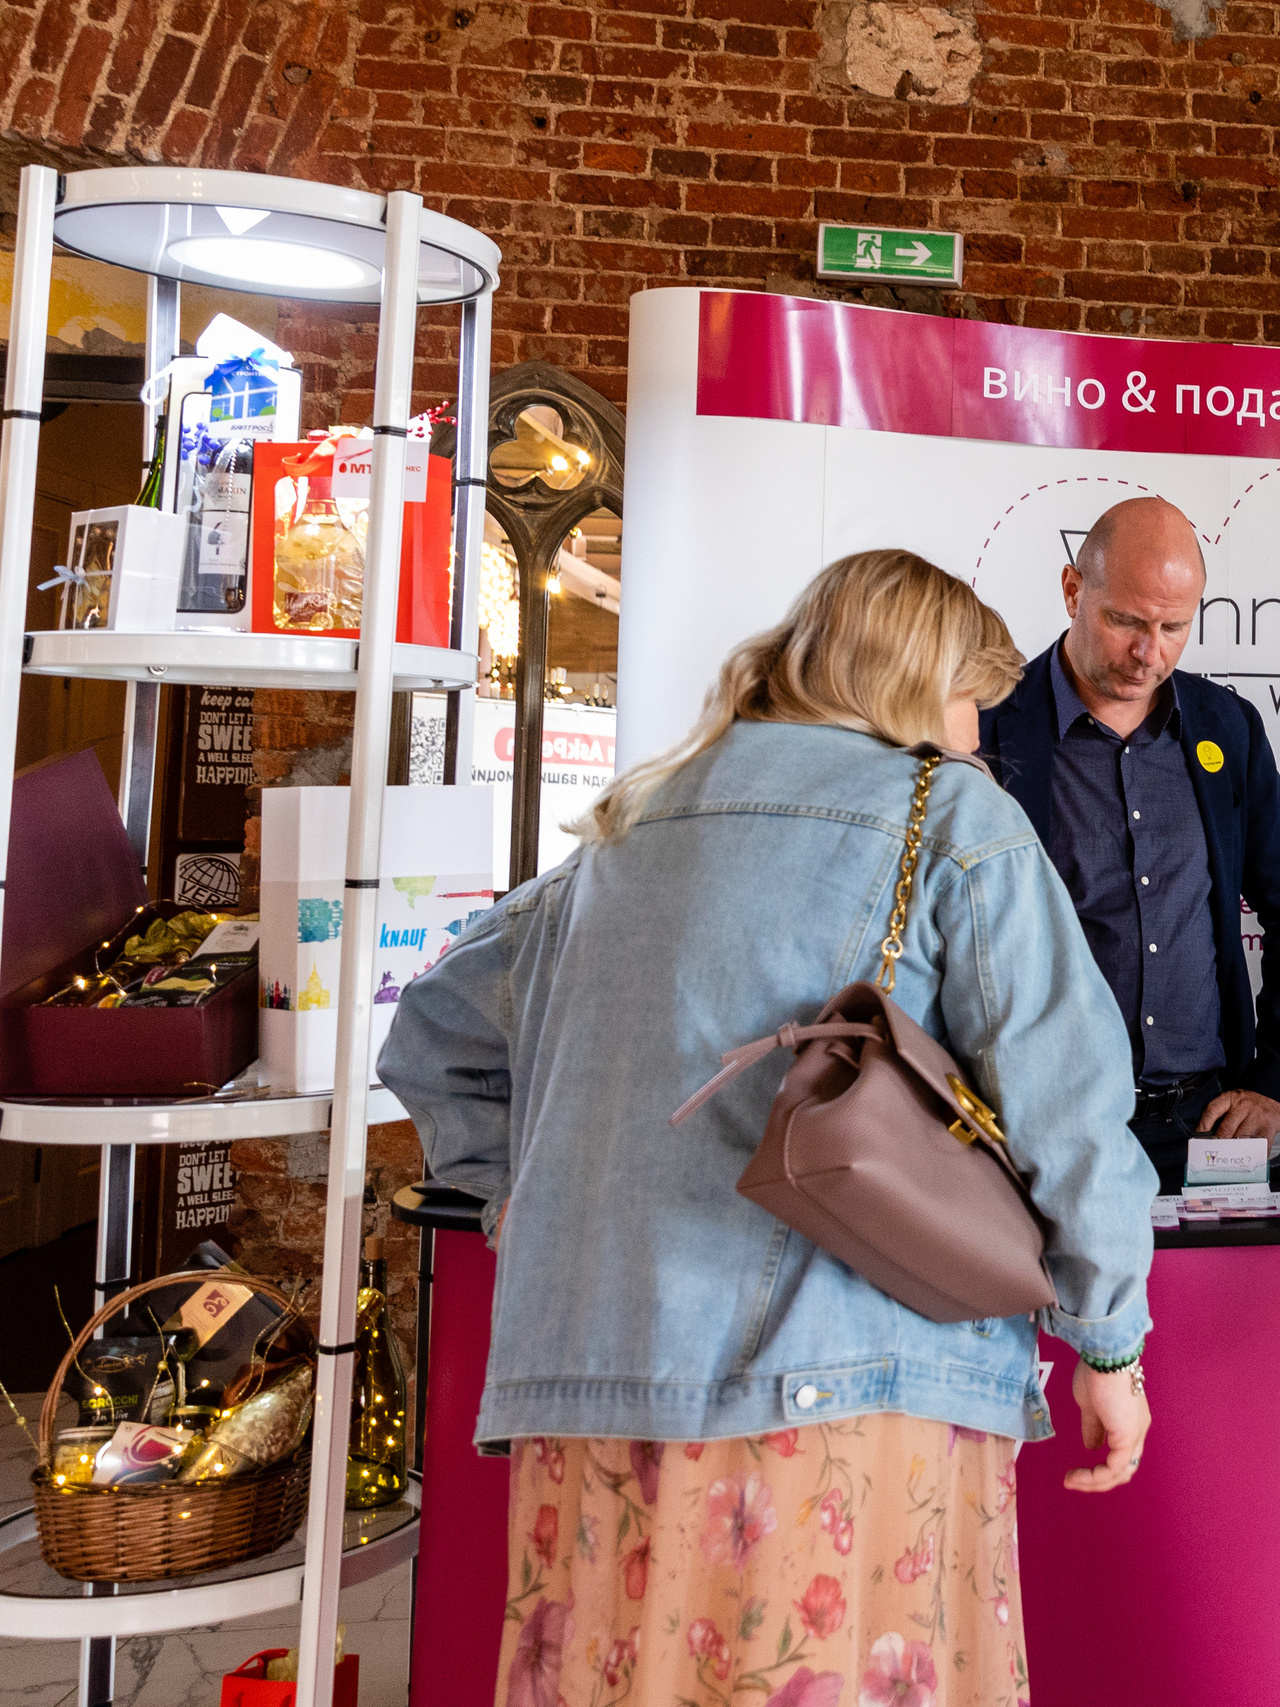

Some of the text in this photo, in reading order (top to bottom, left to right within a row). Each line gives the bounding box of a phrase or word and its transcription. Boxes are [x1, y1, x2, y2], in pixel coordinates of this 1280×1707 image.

[982, 367, 1106, 410] вино
[1121, 370, 1157, 413] &
[200, 690, 233, 711] keep
[199, 711, 227, 724] DON'T
[228, 712, 245, 725] LET
[198, 724, 253, 751] SWEE
[198, 752, 253, 763] A WELL SLEE
[179, 1149, 226, 1167] DON'T LET
[177, 1162, 234, 1194] SWEE
[177, 1190, 235, 1208] A WELL SLEE
